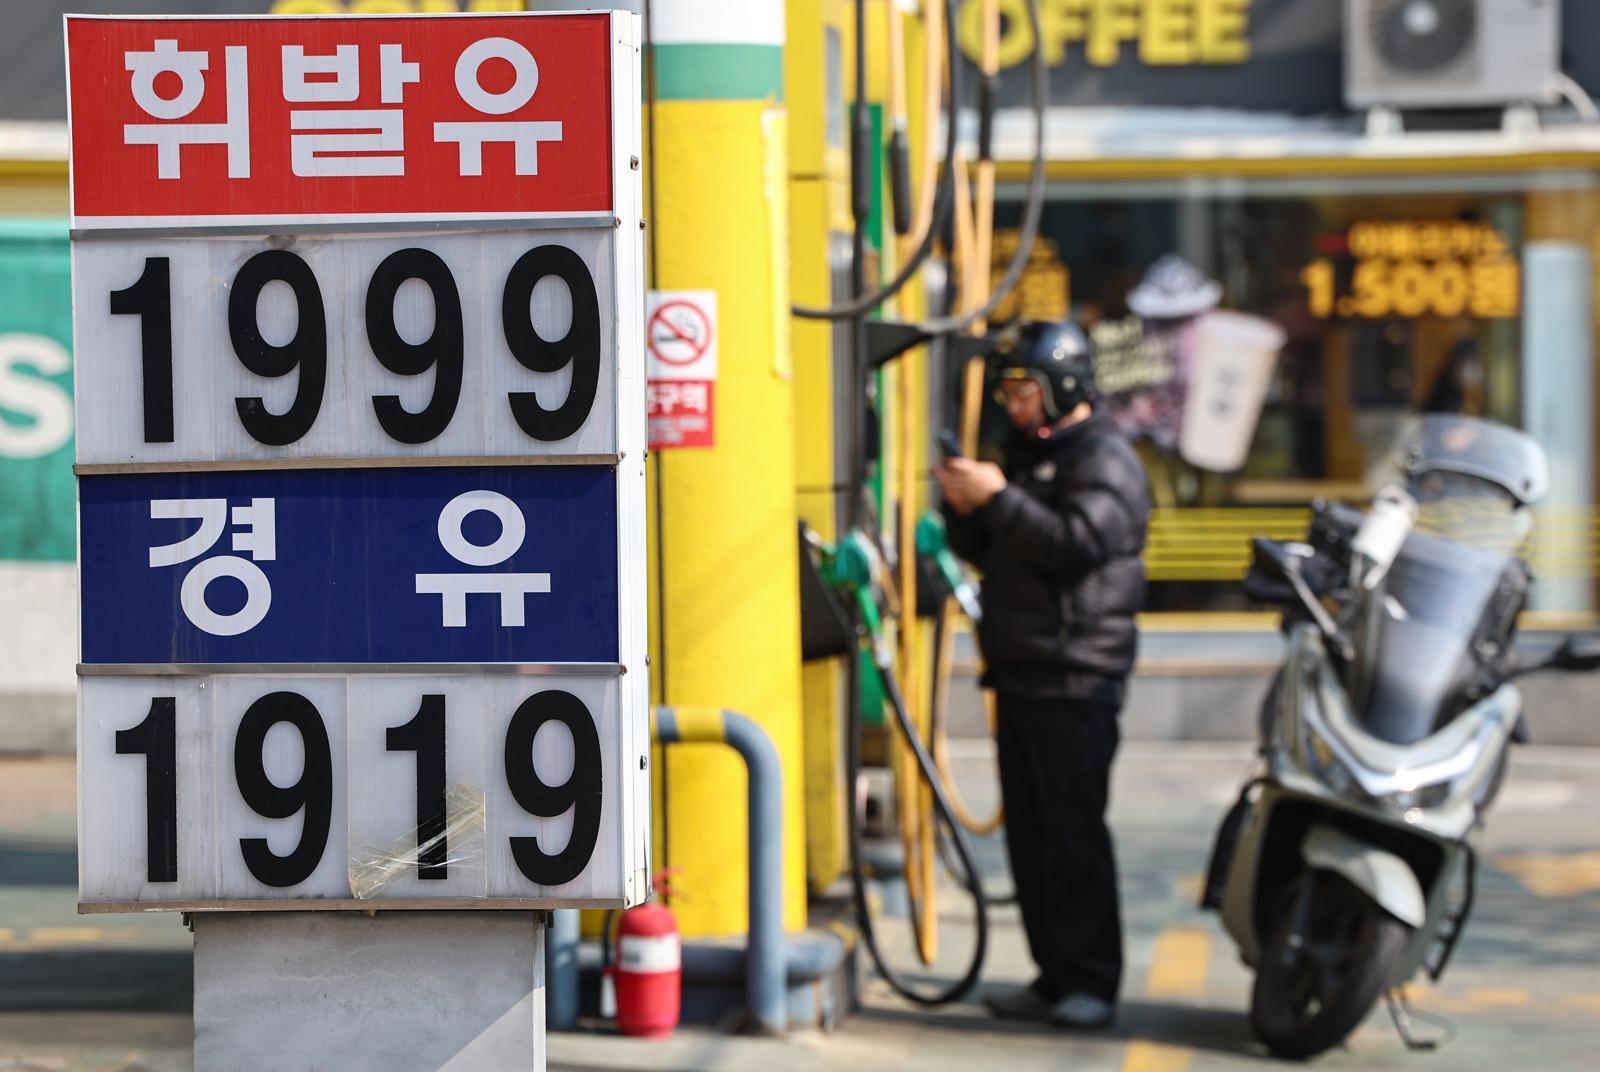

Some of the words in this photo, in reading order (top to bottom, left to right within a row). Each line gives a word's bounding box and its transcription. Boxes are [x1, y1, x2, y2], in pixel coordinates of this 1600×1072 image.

[123, 37, 563, 180] 휘발유
[110, 244, 601, 446] 1999
[648, 382, 708, 414] 구역
[149, 489, 551, 636] 경유
[115, 690, 603, 887] 1919
